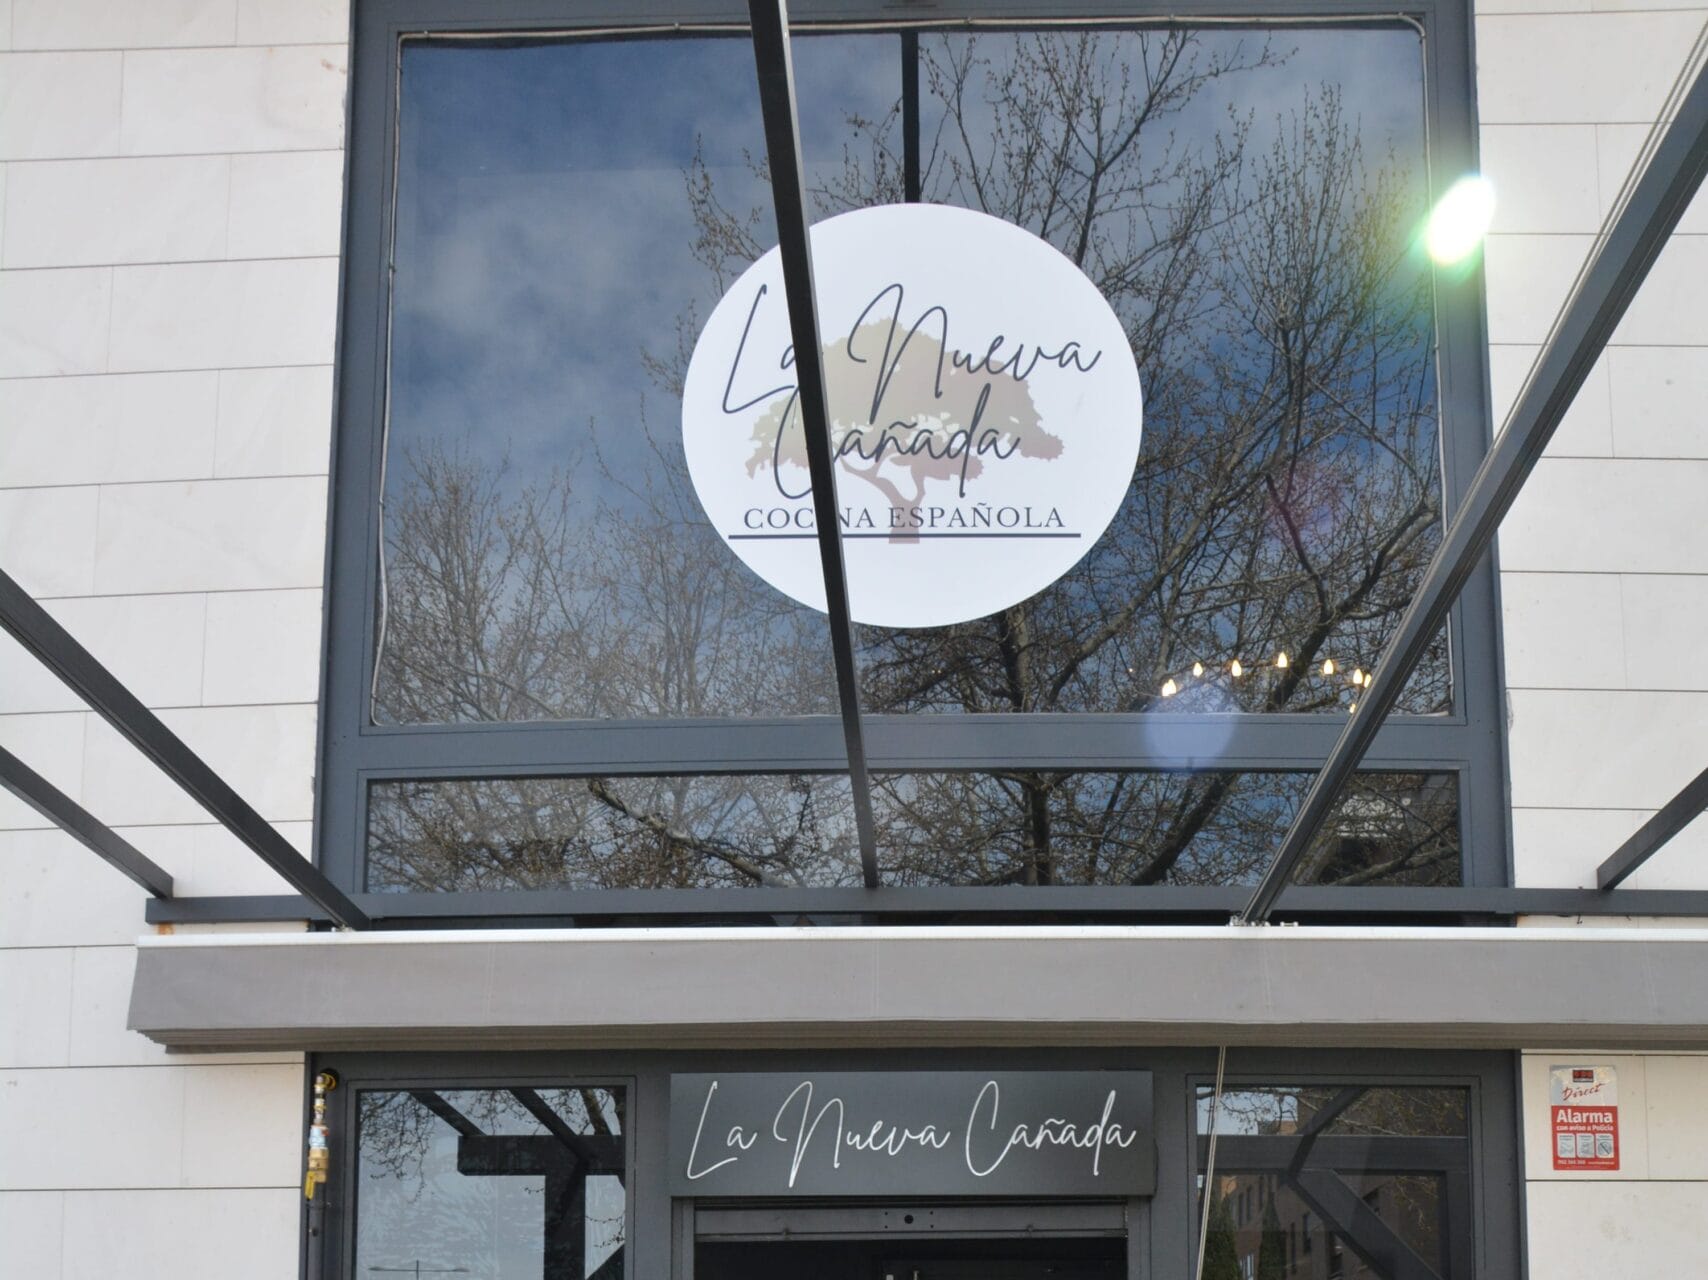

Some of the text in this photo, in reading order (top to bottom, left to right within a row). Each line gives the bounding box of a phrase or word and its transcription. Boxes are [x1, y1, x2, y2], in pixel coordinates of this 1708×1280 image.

[847, 283, 1102, 424] Nueva
[743, 502, 1066, 530] COCNA ESPAÑOLA
[1562, 1083, 1605, 1101] Direct
[1557, 1109, 1613, 1123] Alarma
[687, 1080, 1137, 1189] La Nueva Cañada
